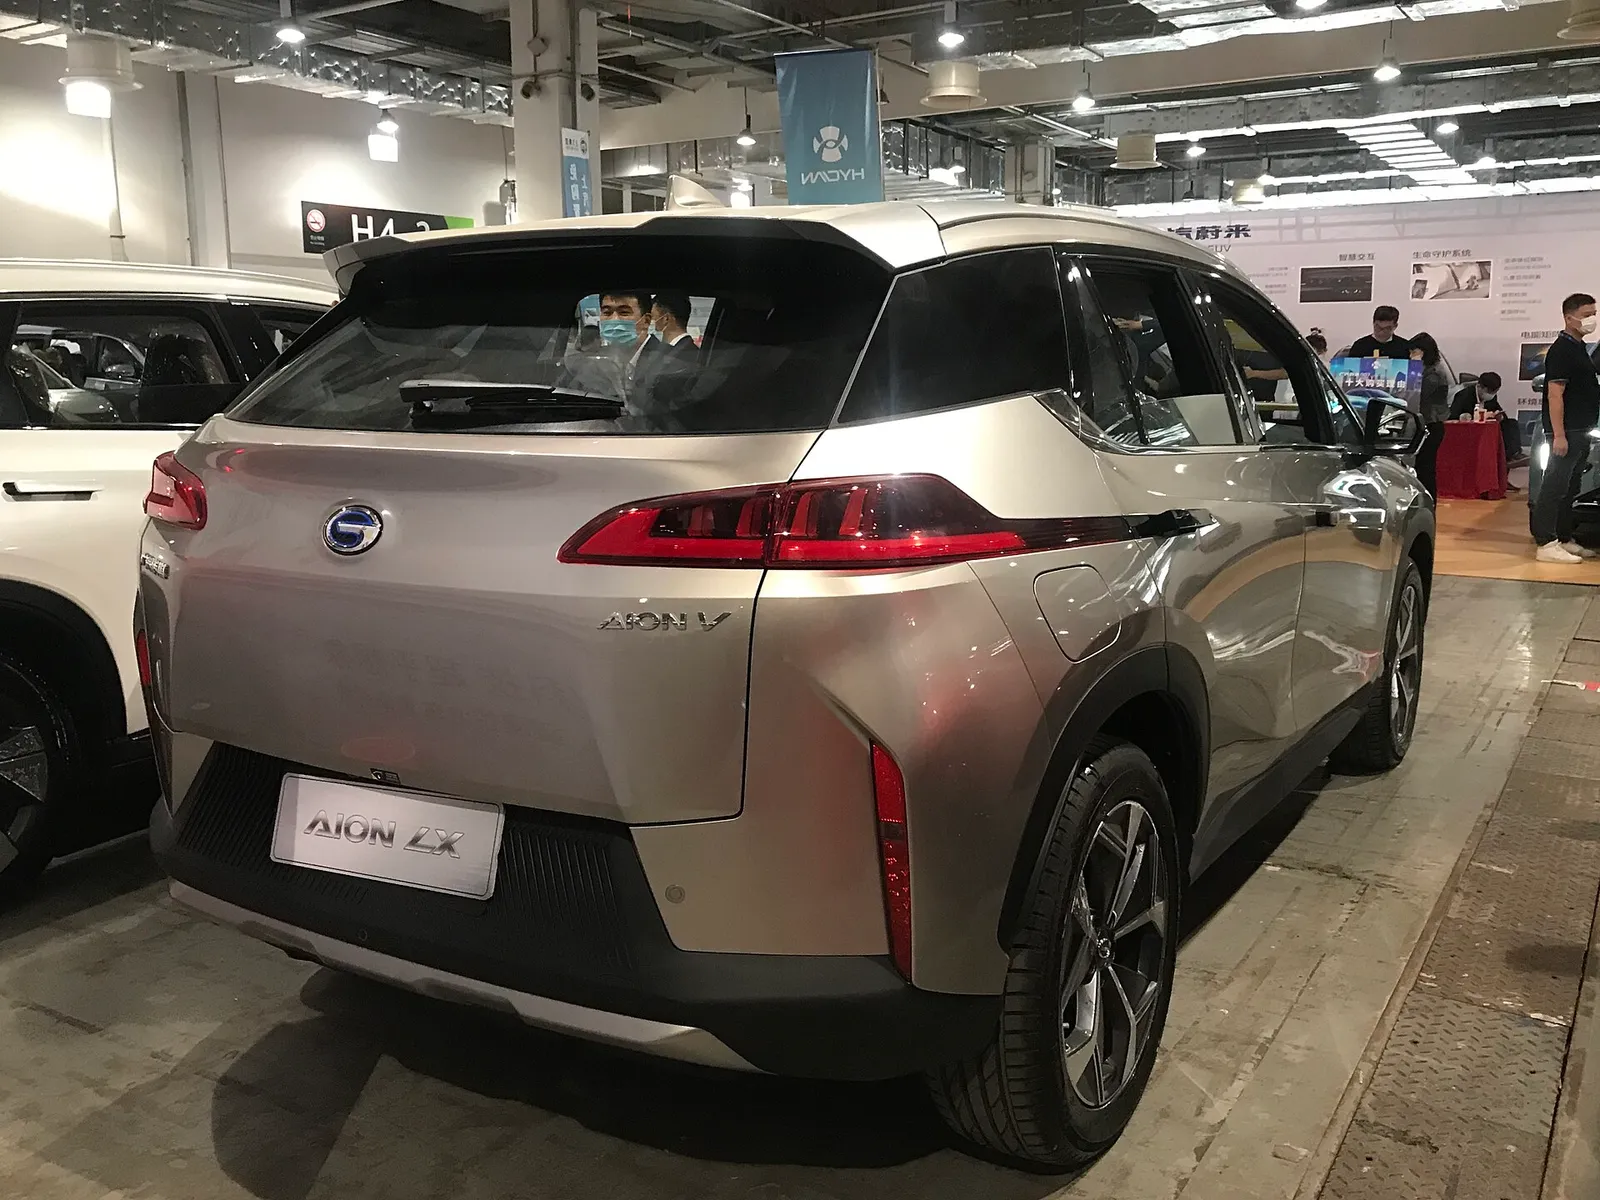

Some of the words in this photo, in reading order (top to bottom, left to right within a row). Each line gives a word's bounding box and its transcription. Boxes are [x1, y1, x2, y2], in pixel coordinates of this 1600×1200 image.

[1412, 249, 1472, 259] 生命守护系统
[1345, 379, 1407, 388] 十大购买理由
[597, 611, 688, 631] AION
[697, 611, 732, 632] V
[303, 809, 397, 849] AION
[403, 826, 465, 860] LX
